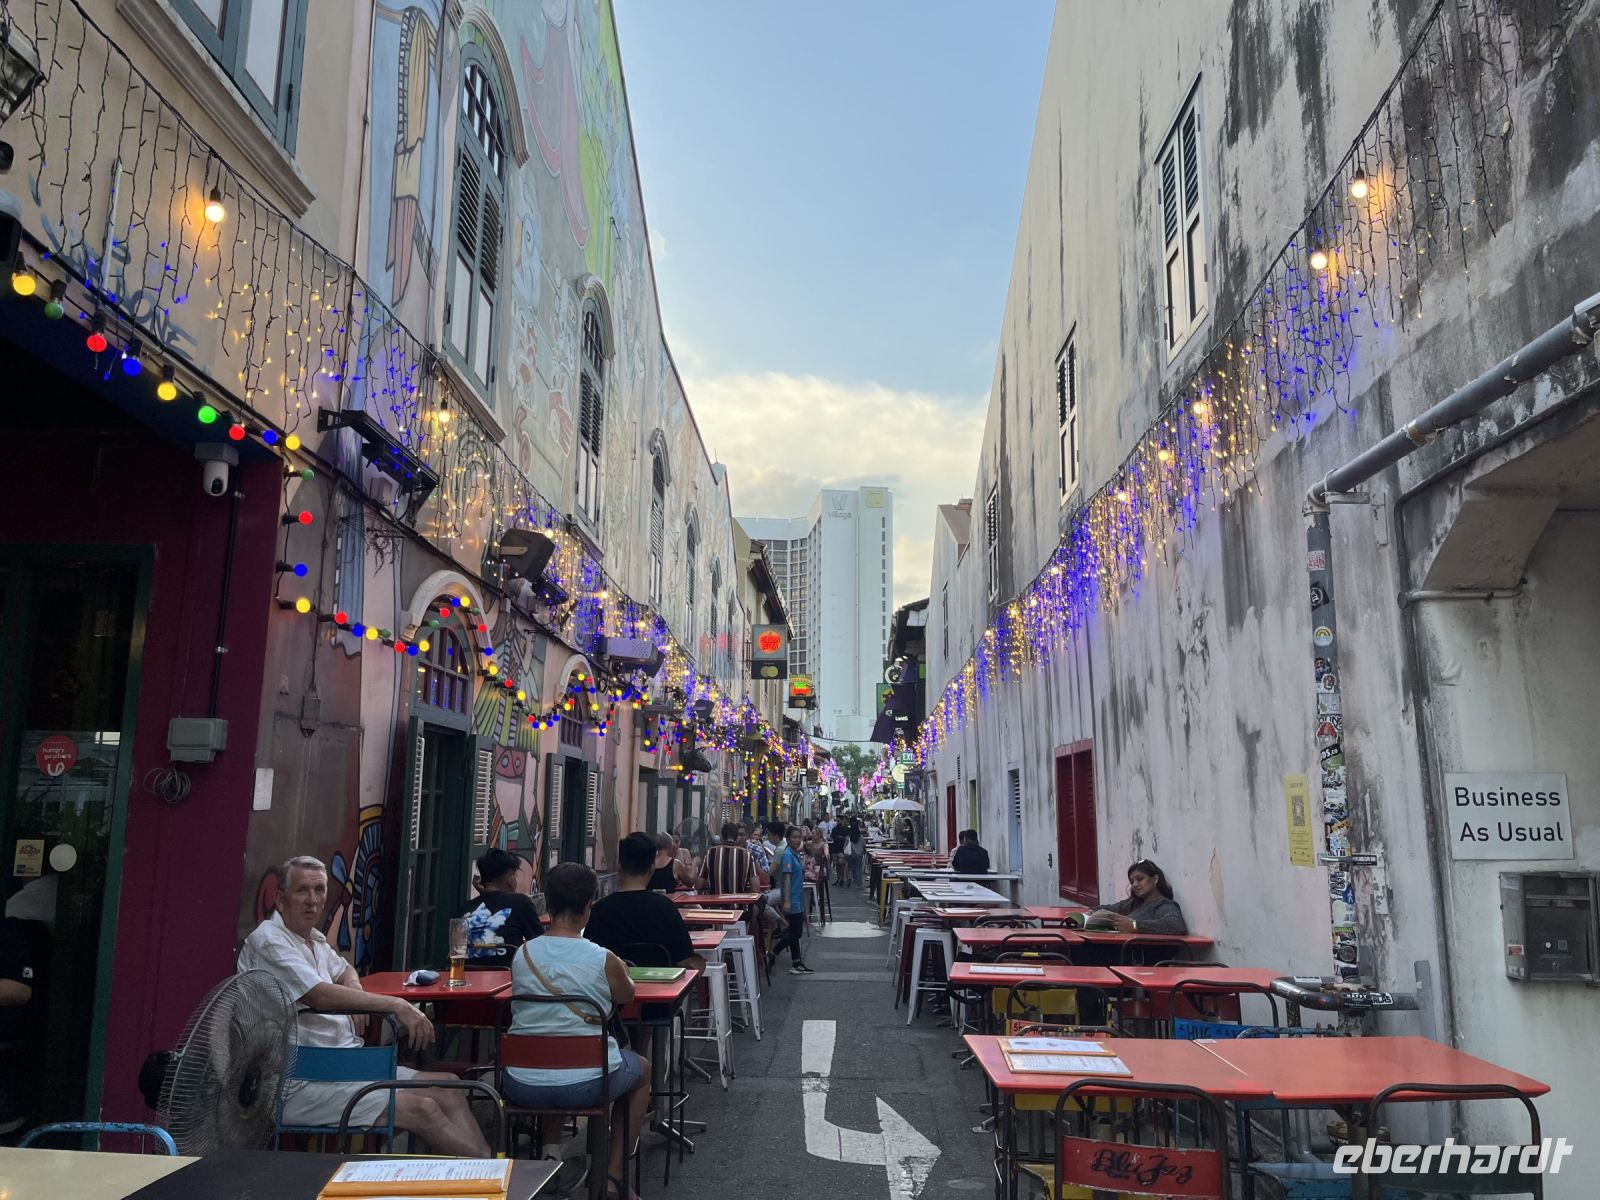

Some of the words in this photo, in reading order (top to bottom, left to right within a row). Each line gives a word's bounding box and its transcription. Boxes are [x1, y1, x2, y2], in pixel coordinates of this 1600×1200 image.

[1454, 786, 1561, 807] Business
[1459, 821, 1489, 842] As
[1497, 821, 1564, 842] Usual
